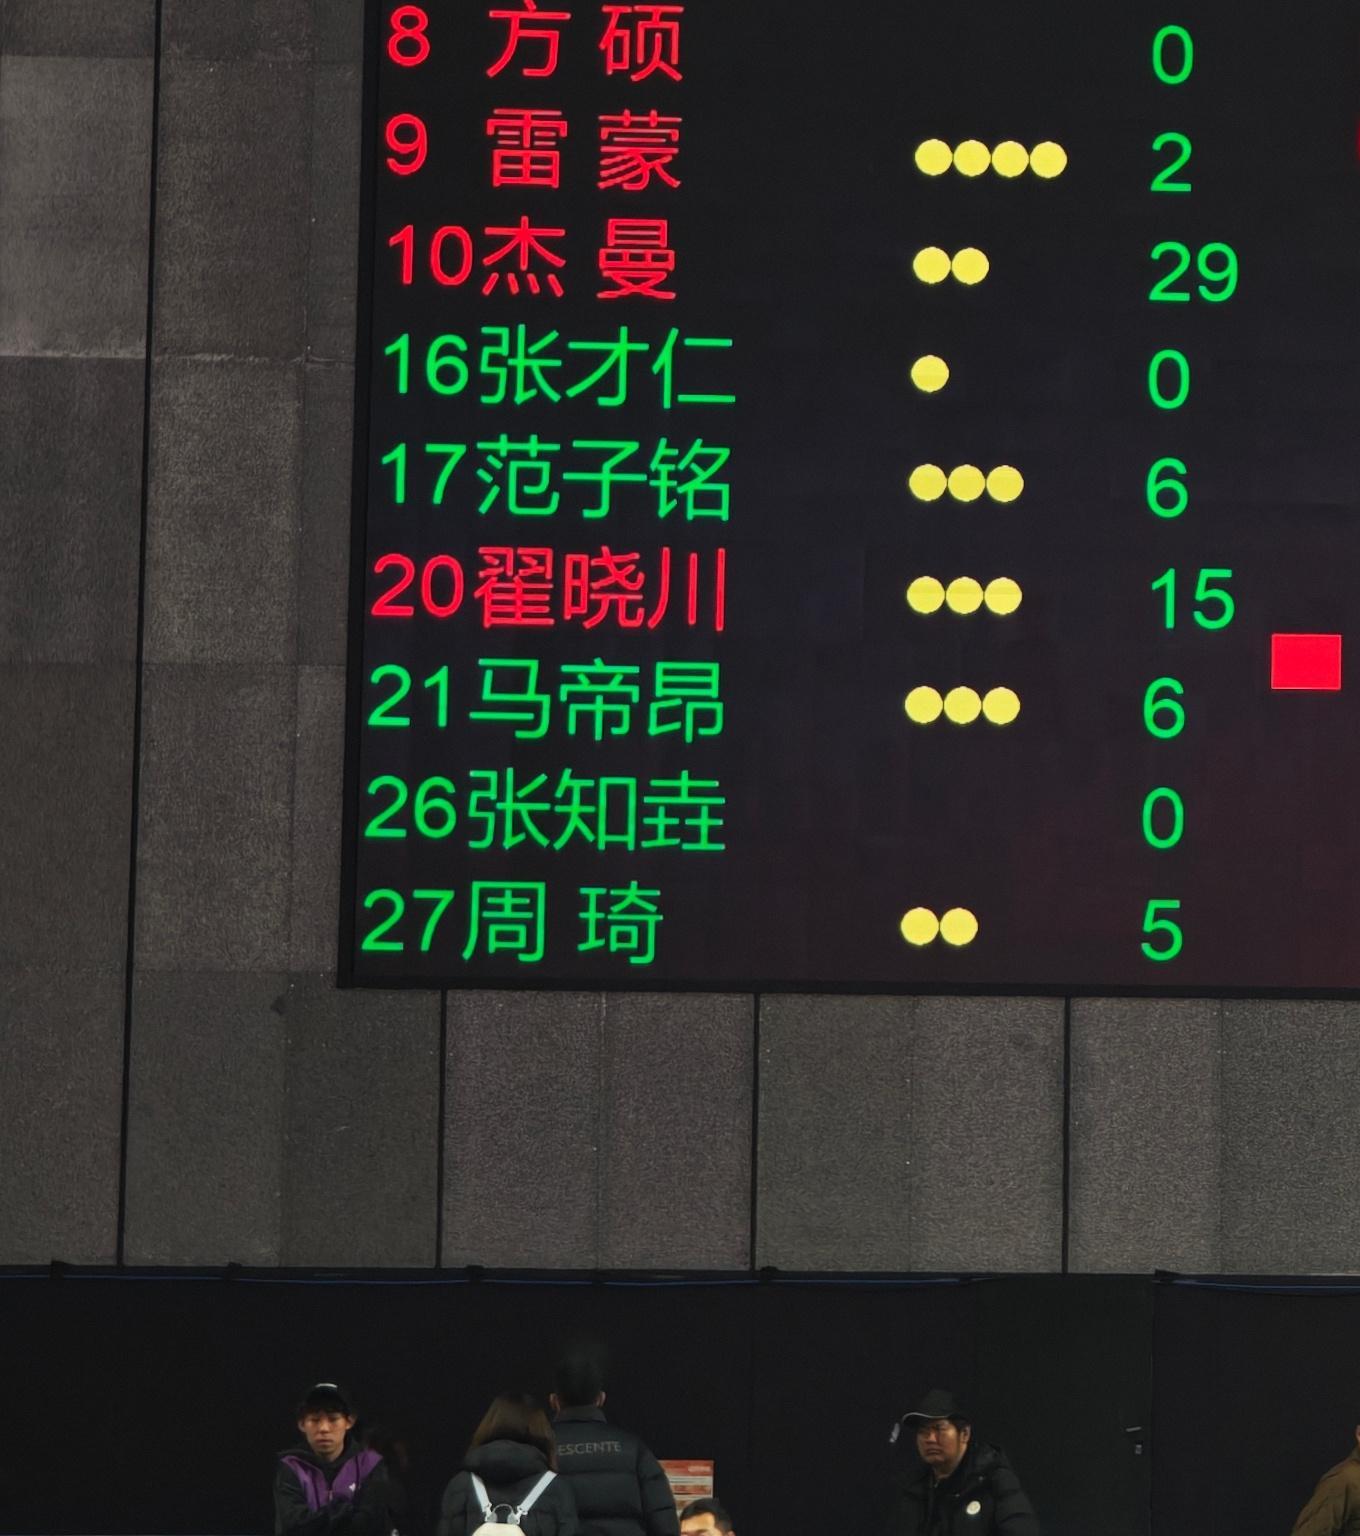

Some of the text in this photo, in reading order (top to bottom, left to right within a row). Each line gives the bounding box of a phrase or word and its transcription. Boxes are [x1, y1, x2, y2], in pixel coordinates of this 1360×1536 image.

[385, 3, 432, 69] 8
[1151, 23, 1195, 86] 0
[383, 111, 429, 177] 9
[1149, 131, 1193, 193] 2
[1147, 240, 1239, 304] 29
[1147, 348, 1191, 411] 0
[1145, 456, 1190, 520] 6
[1150, 566, 1236, 631] 15
[1142, 676, 1186, 740] 6
[1141, 786, 1185, 850] 0
[1140, 898, 1184, 962] 5
[557, 1440, 622, 1456] ESCENTE
